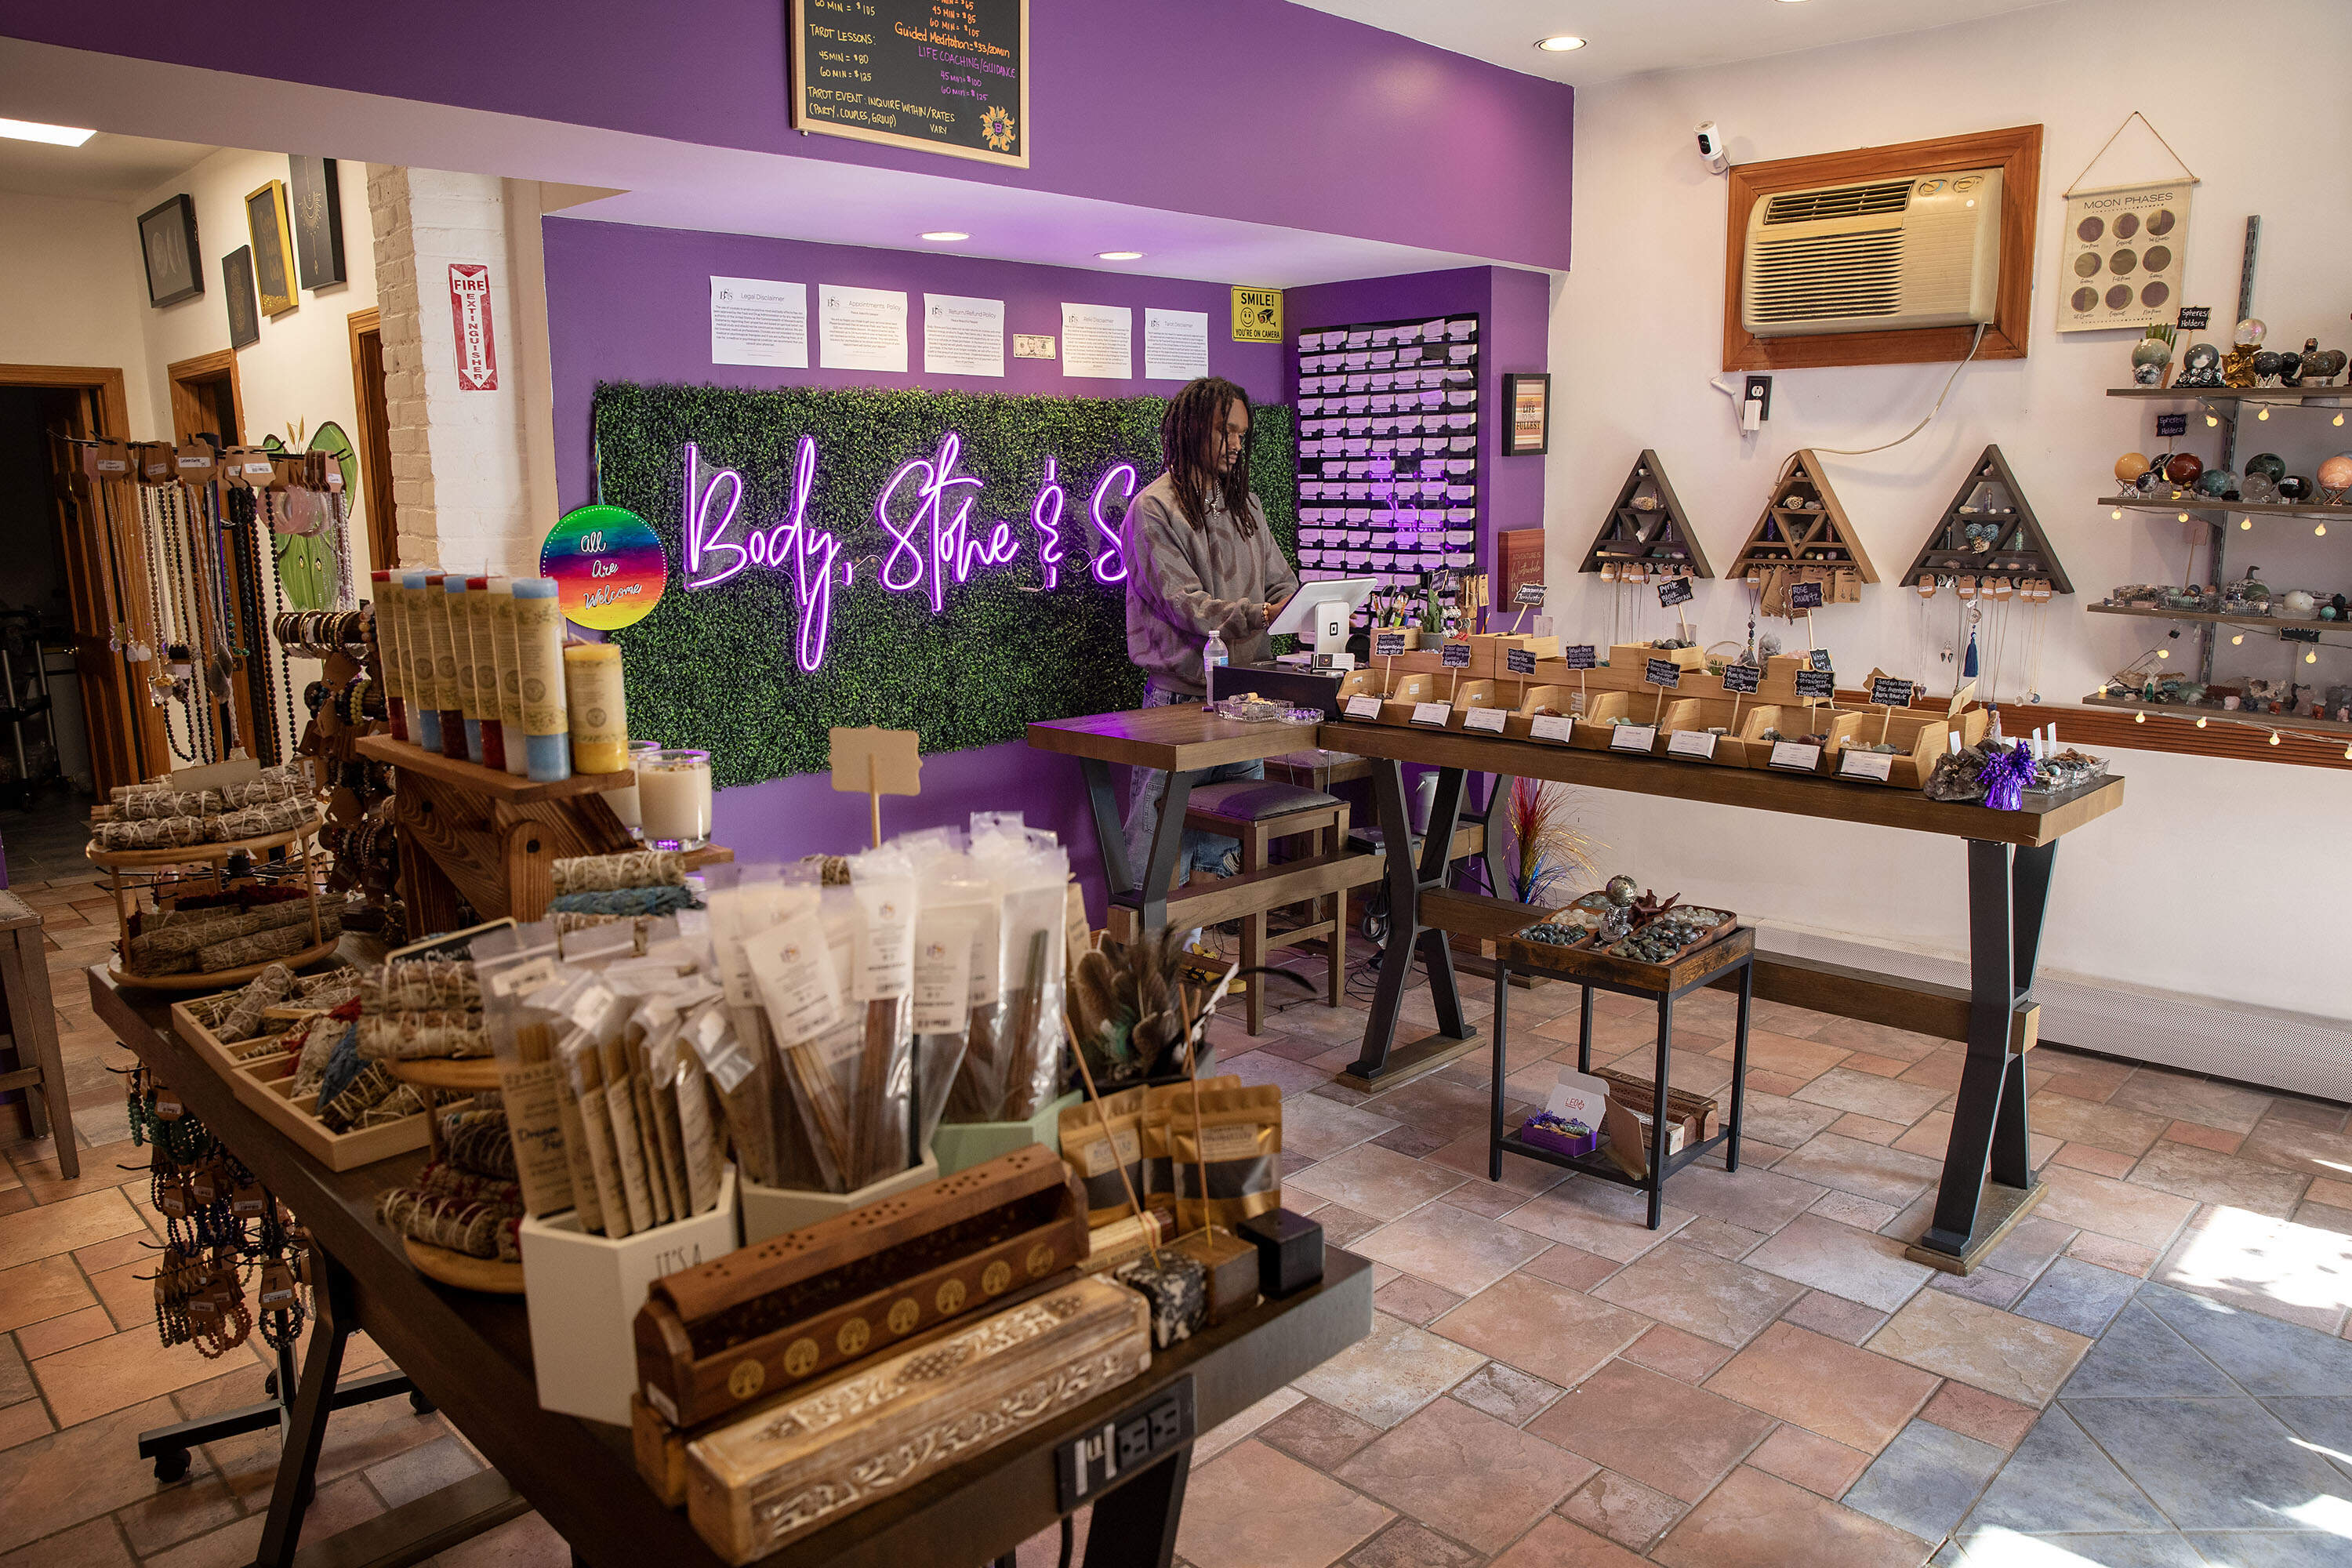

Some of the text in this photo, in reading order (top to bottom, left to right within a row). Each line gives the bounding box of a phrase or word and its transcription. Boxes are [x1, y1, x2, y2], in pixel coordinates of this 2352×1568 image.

[827, 2, 844, 13] MIN
[856, 2, 876, 16] $105
[932, 5, 942, 15] 45
[943, 9, 955, 19] MIN
[930, 17, 939, 27] 60
[809, 24, 877, 45] TAROT LESSONS:
[895, 21, 927, 42] Guided
[854, 54, 869, 64] $80
[918, 45, 938, 61] LIFE
[819, 66, 831, 77] 60
[832, 69, 847, 78] MIN
[854, 70, 872, 82] $125
[807, 86, 833, 100] TAROT
[868, 96, 901, 111] INQUIRE
[930, 124, 947, 135] VARY
[2084, 192, 2173, 209] MOON PHASES
[454, 280, 485, 291] FIRE
[1240, 292, 1274, 307] SMILE!
[2181, 318, 2205, 327] Holders
[466, 293, 483, 380] EXTINGUISHER
[1235, 328, 1253, 337] YOU'RE
[1262, 330, 1280, 339] CAMERA
[1523, 405, 1535, 413] LIFE
[1516, 421, 1541, 430] FULLEST
[878, 432, 1020, 615] Stone
[580, 531, 607, 554] All
[591, 559, 619, 579] Are
[583, 583, 643, 610] Welcome
[1565, 1097, 1579, 1107] LEO
